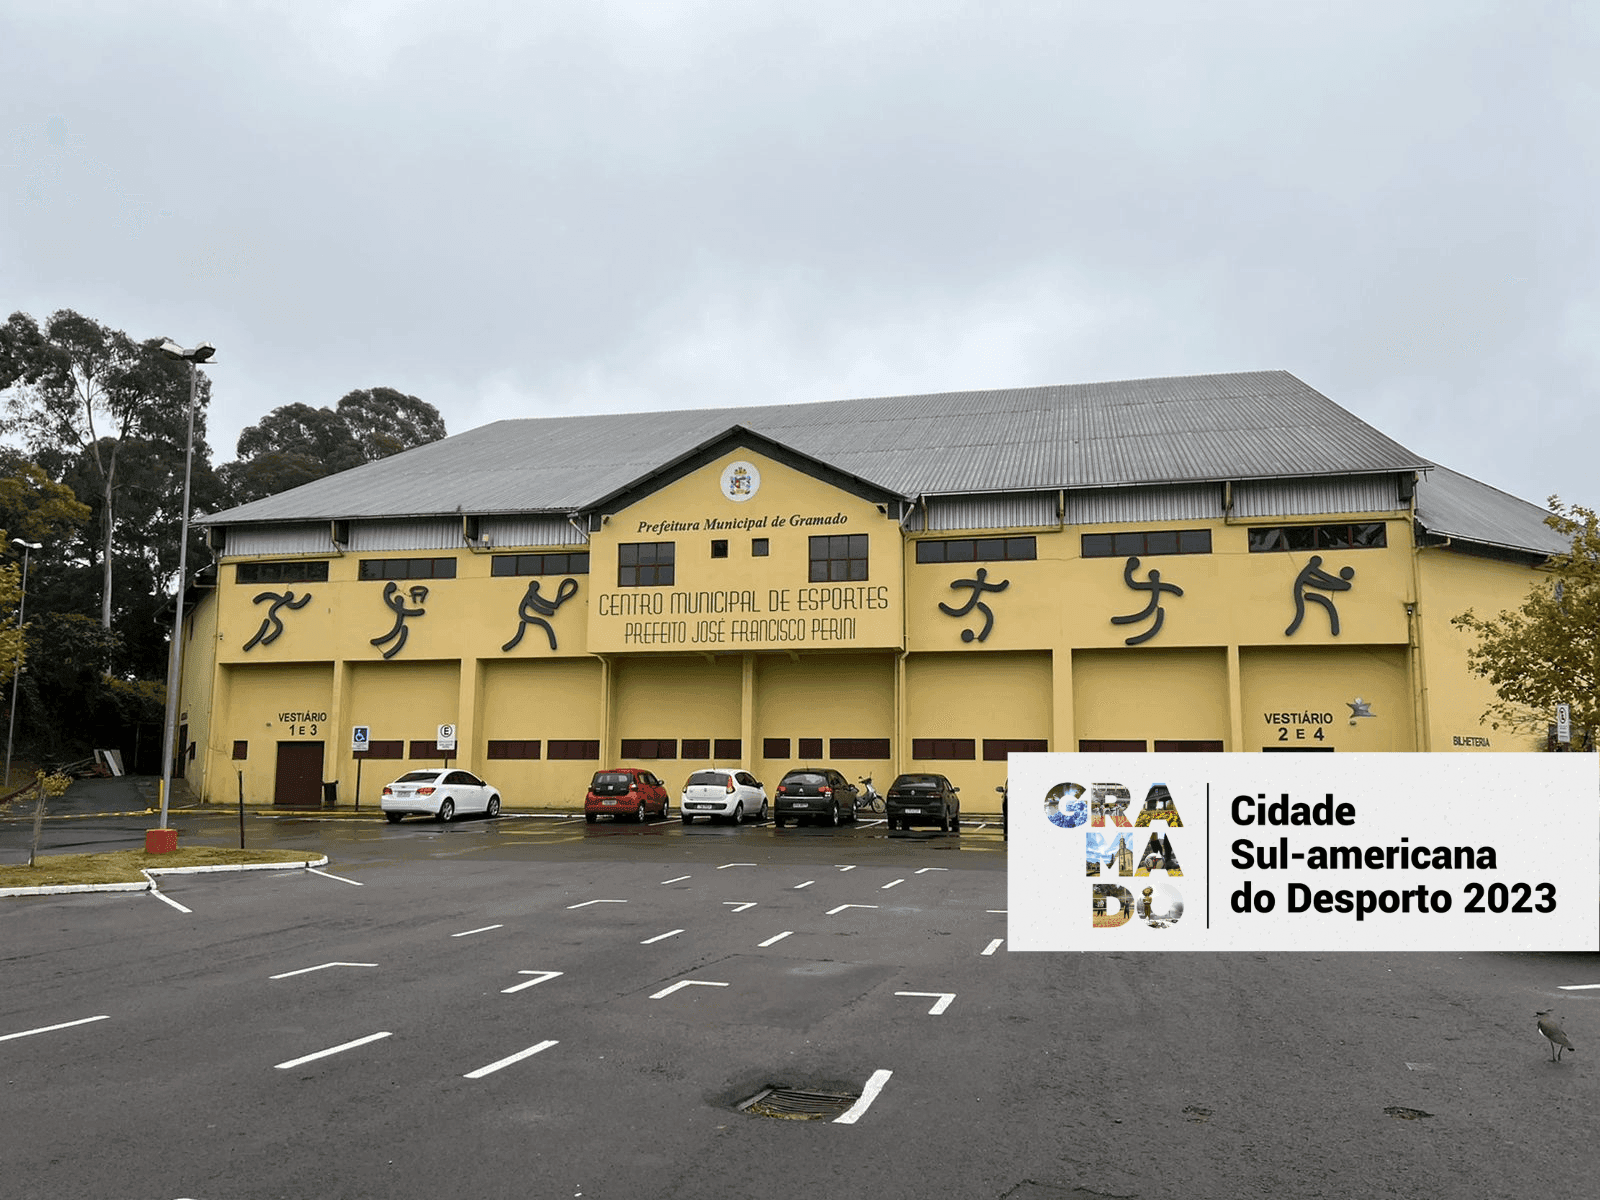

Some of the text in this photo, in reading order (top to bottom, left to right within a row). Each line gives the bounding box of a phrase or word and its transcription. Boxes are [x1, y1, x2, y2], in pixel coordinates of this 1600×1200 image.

[637, 512, 848, 536] Prefeitura Municipal de Gramado
[599, 586, 889, 616] CENTRO MUNICIPAL DE ESPORTES
[624, 617, 856, 644] PREFEITO JOSÉ FRANCISCO PERINI
[278, 710, 327, 723] VESTIÁRIO
[1264, 710, 1333, 725] VESTIÁRIO
[289, 724, 318, 736] 1 E 3
[1278, 727, 1325, 741] 2 E 4
[1453, 735, 1490, 747] BILHETERIA
